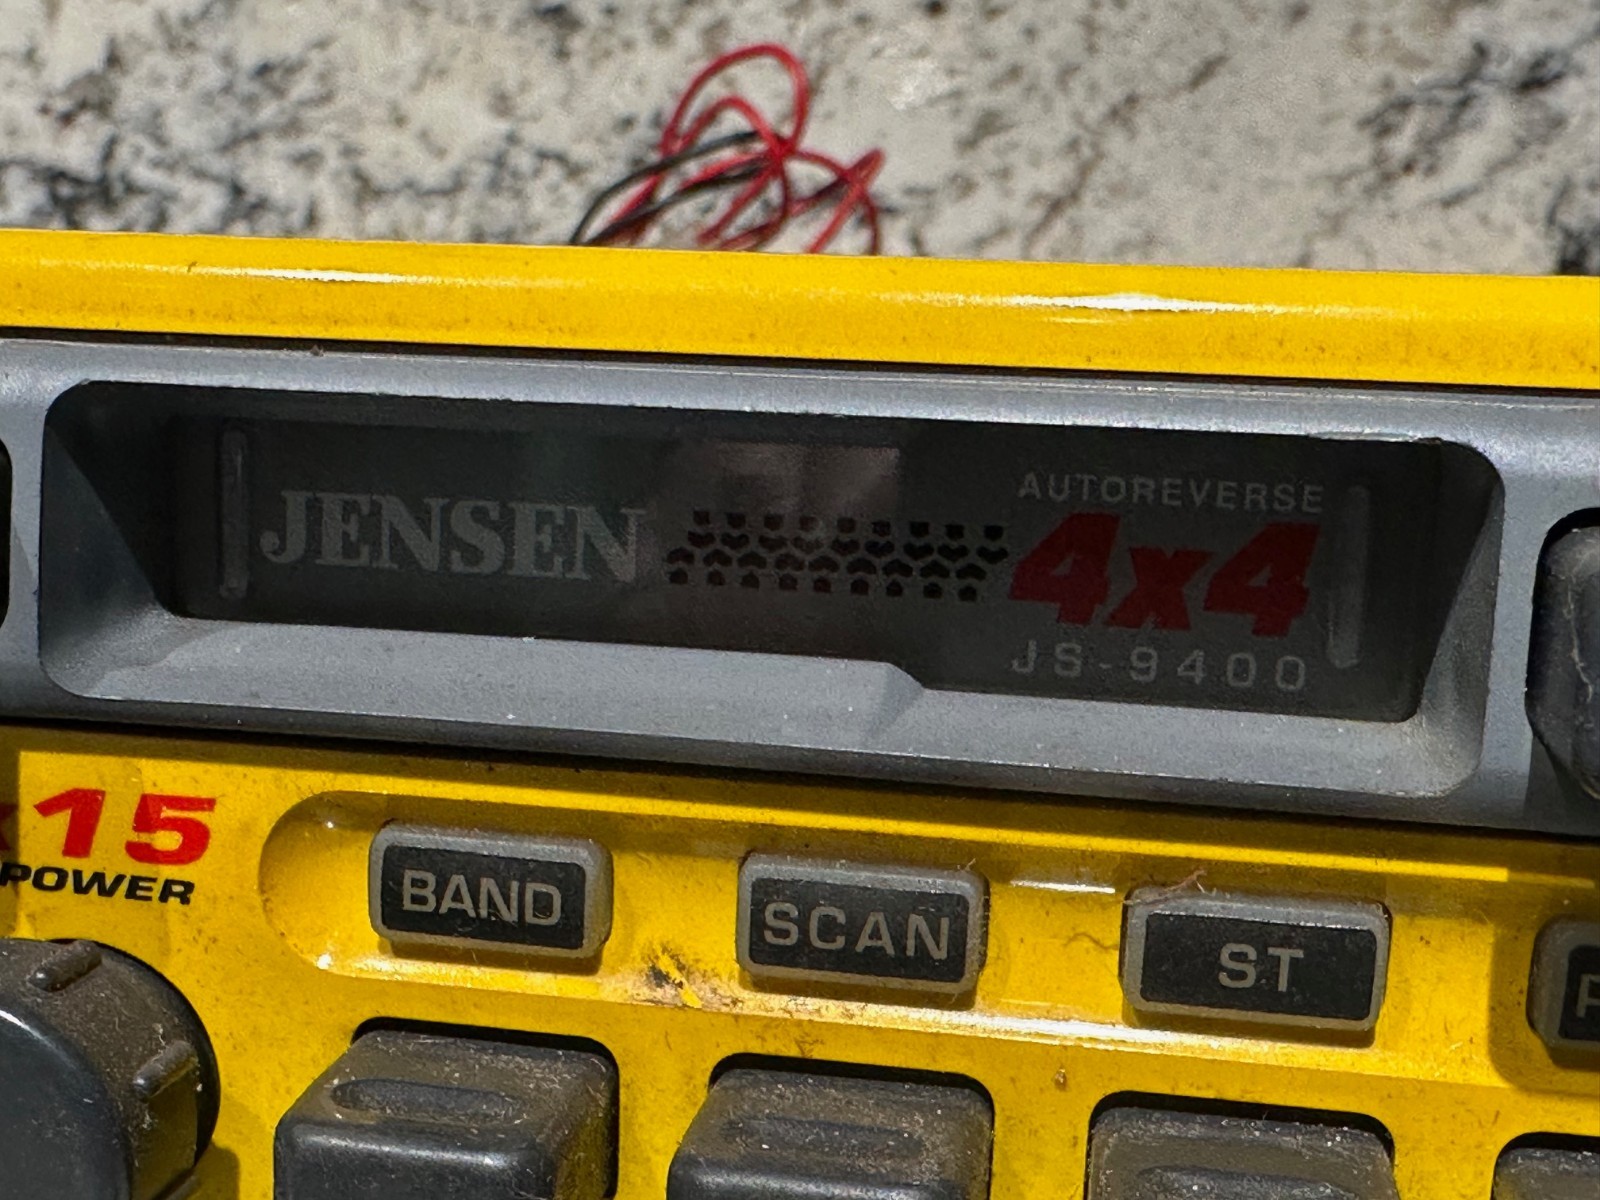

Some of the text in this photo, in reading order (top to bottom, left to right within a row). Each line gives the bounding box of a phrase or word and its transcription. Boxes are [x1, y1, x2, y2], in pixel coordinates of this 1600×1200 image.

[1017, 471, 1324, 514] AUTOREVERSE
[259, 490, 646, 583] JENSEN
[1009, 511, 1320, 638] 4x4
[1010, 639, 1306, 691] JS-9400
[0, 862, 196, 906] POWER
[401, 869, 562, 927] BAND
[763, 902, 951, 960] SCAN
[1217, 942, 1304, 992] ST
